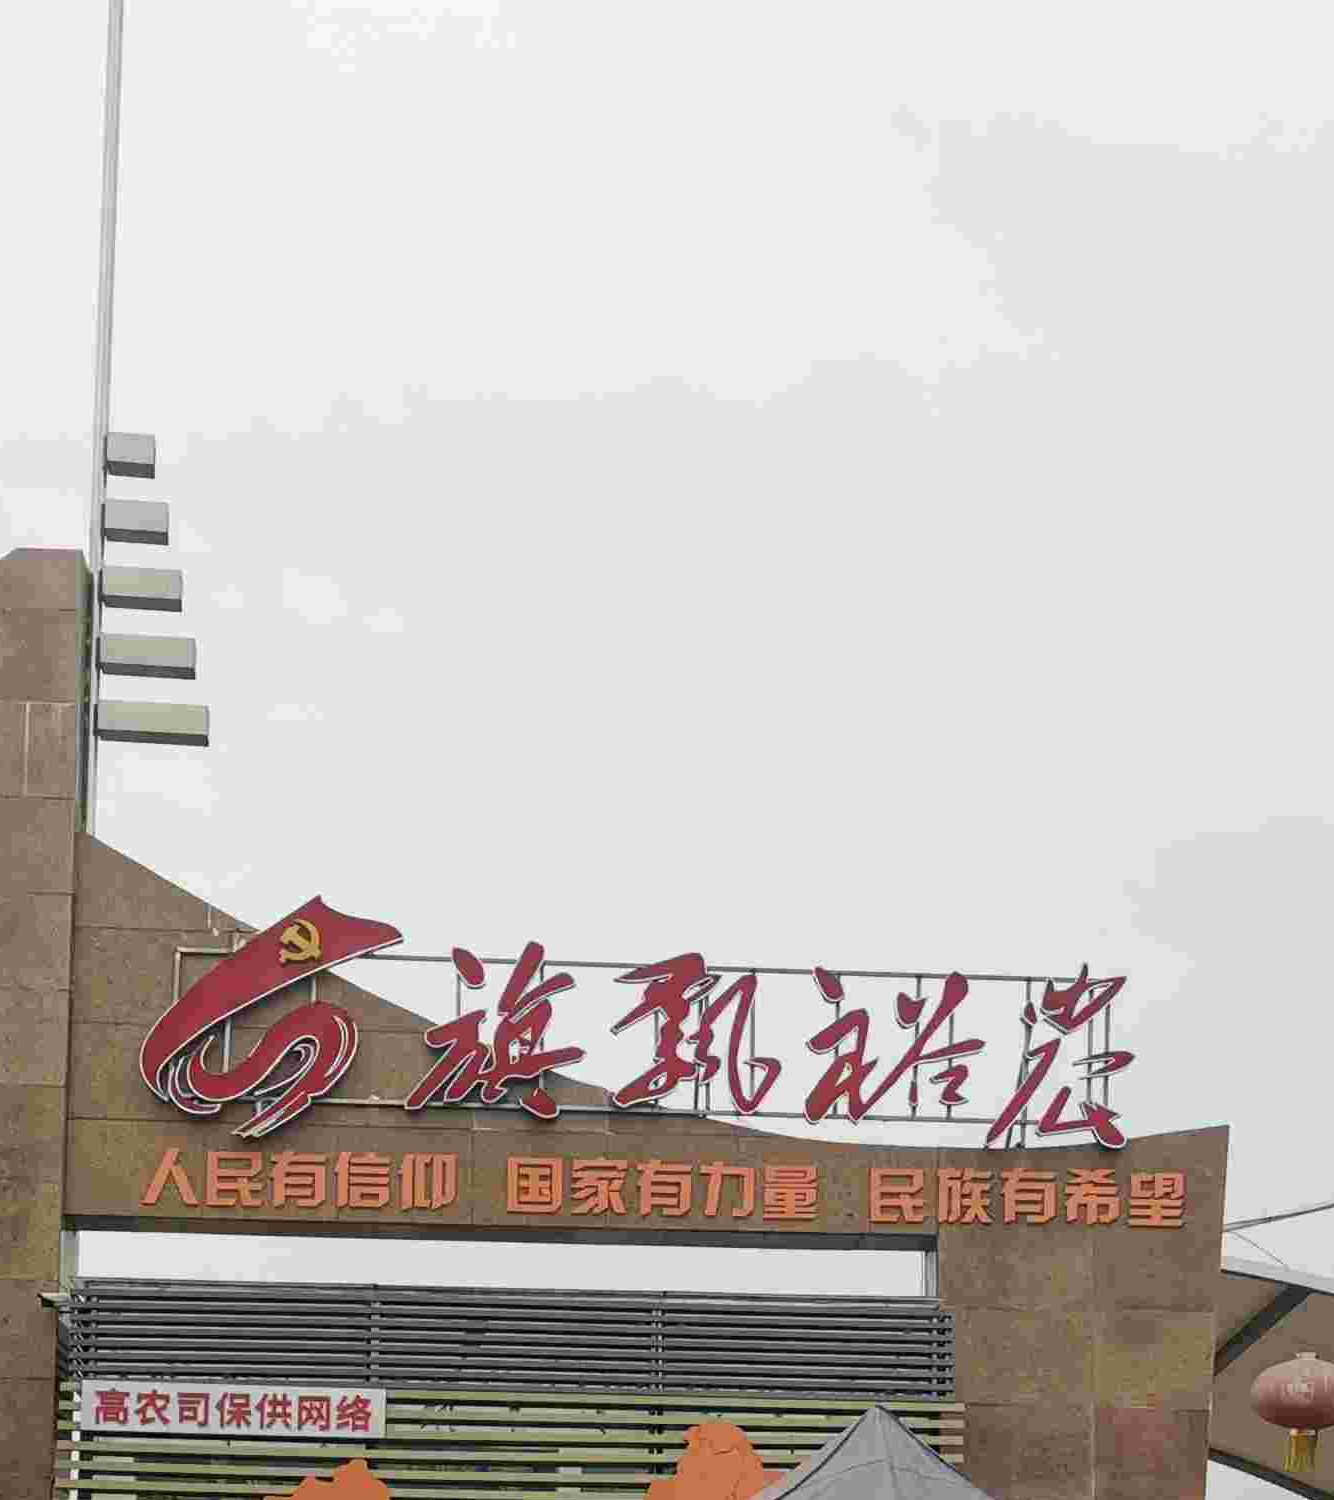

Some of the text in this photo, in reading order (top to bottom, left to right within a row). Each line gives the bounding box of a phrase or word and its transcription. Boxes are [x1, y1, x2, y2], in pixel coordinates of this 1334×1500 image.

[142, 1150, 1186, 1229] 人民有信仰 国家有力量 民族有希望
[95, 1389, 373, 1432] 高农司保供网络
